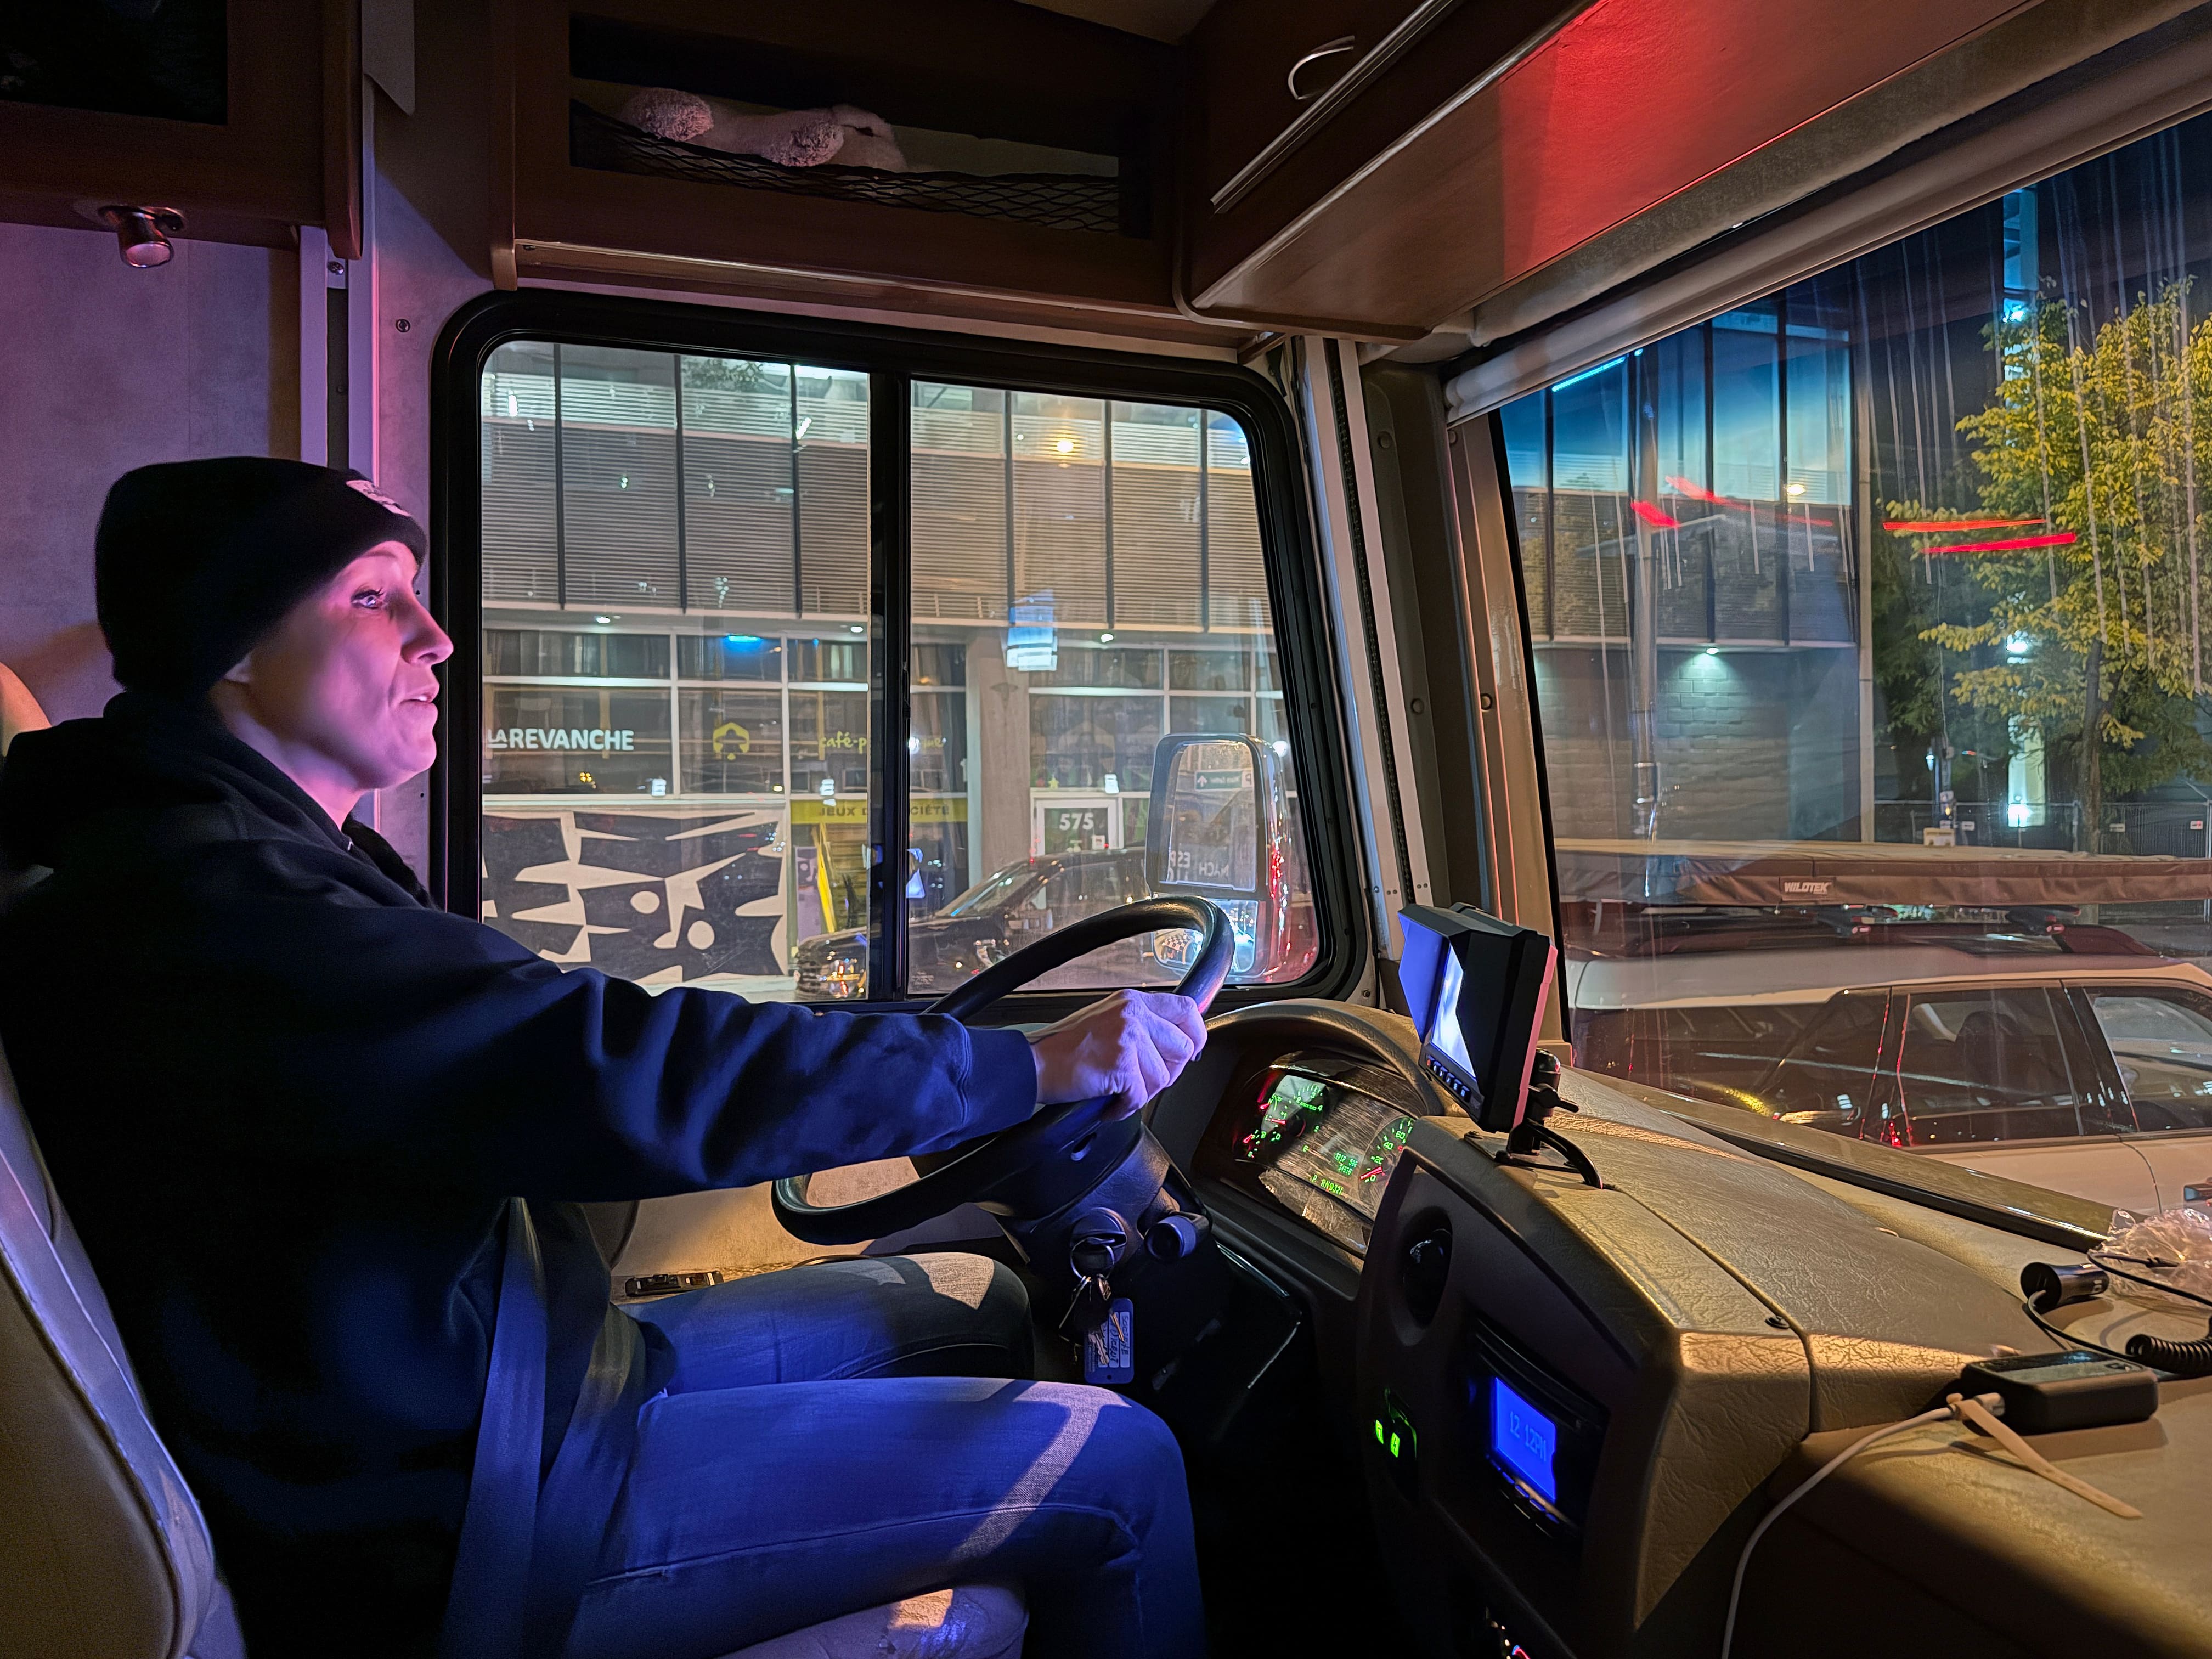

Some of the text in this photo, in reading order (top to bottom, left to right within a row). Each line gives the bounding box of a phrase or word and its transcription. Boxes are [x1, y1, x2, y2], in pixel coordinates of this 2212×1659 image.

[487, 728, 635, 751] LA REVANCHE
[819, 807, 855, 816] JEUX
[1059, 812, 1094, 831] 575
[1784, 882, 1832, 893] WILDTEK
[1395, 1130, 1406, 1139] 60
[1383, 1142, 1393, 1150] 40
